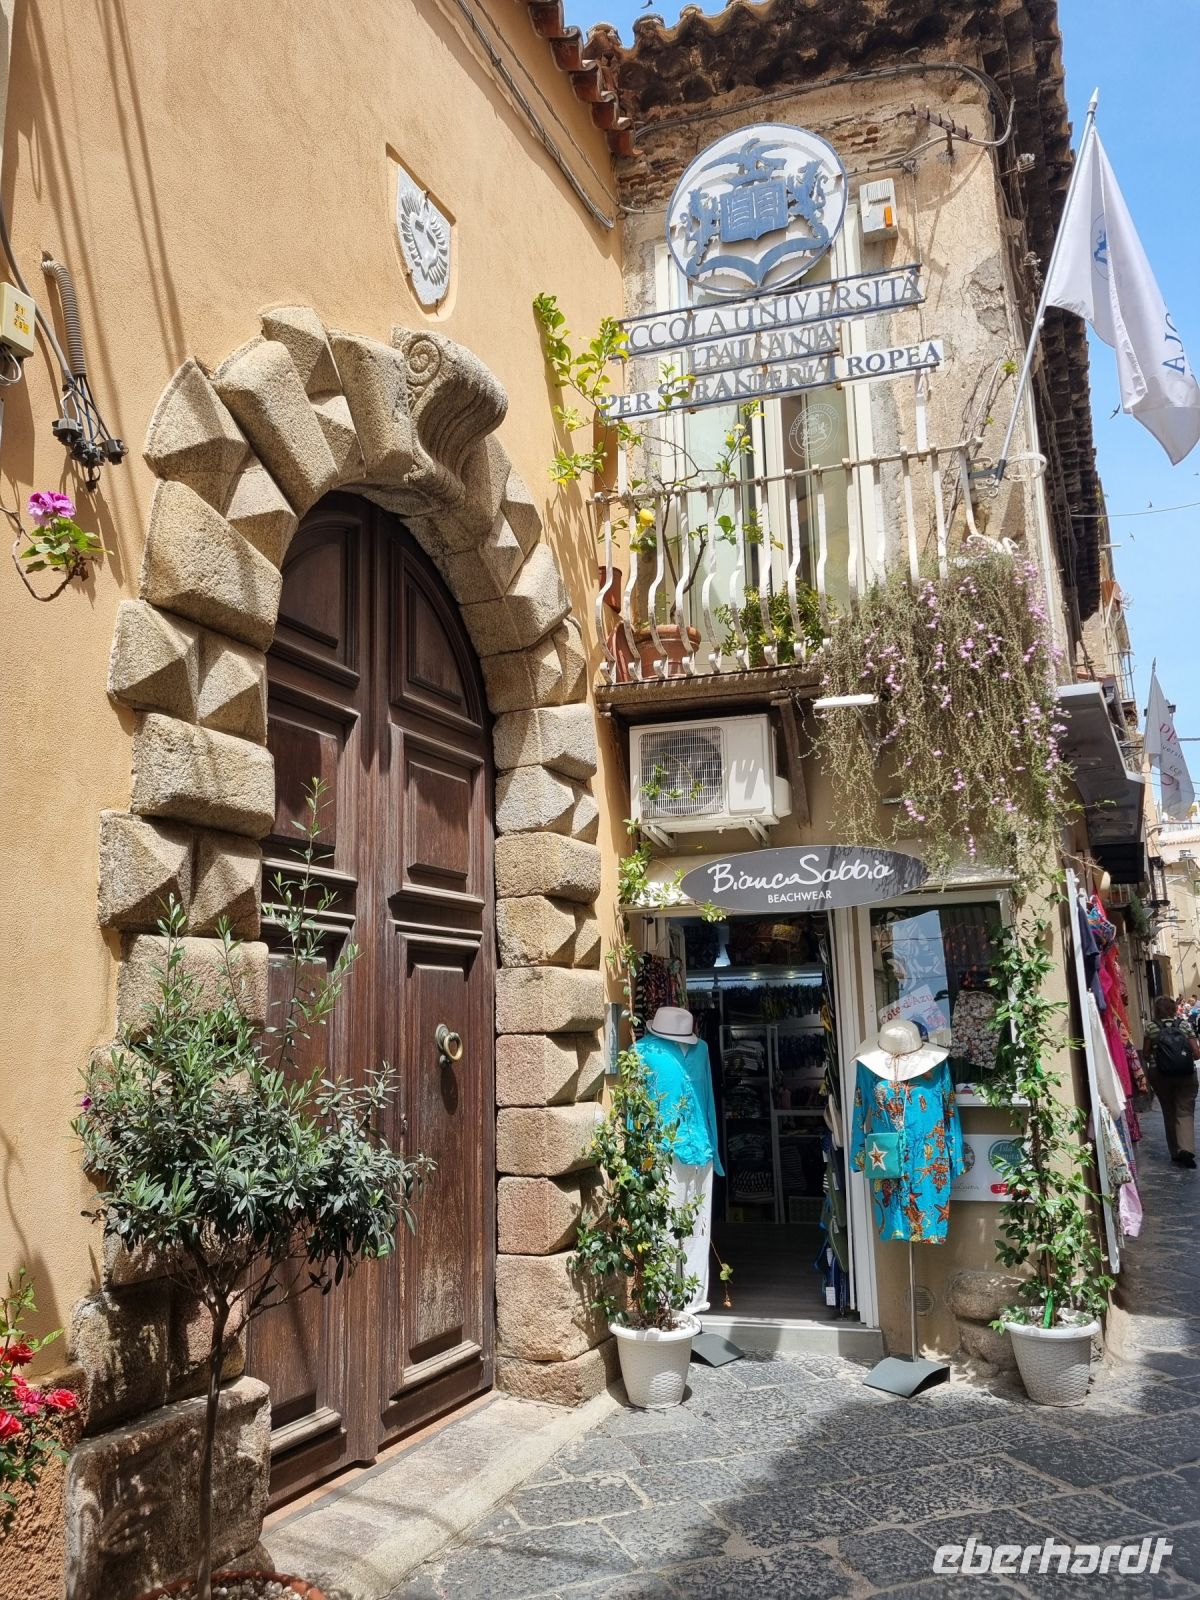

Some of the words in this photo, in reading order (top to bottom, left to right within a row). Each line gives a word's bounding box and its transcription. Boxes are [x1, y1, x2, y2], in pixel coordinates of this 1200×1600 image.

[612, 311, 726, 353] ICCOLA
[688, 323, 837, 374] ITALIANA
[599, 391, 652, 418] PER
[767, 889, 833, 904] BEACHWEAR
